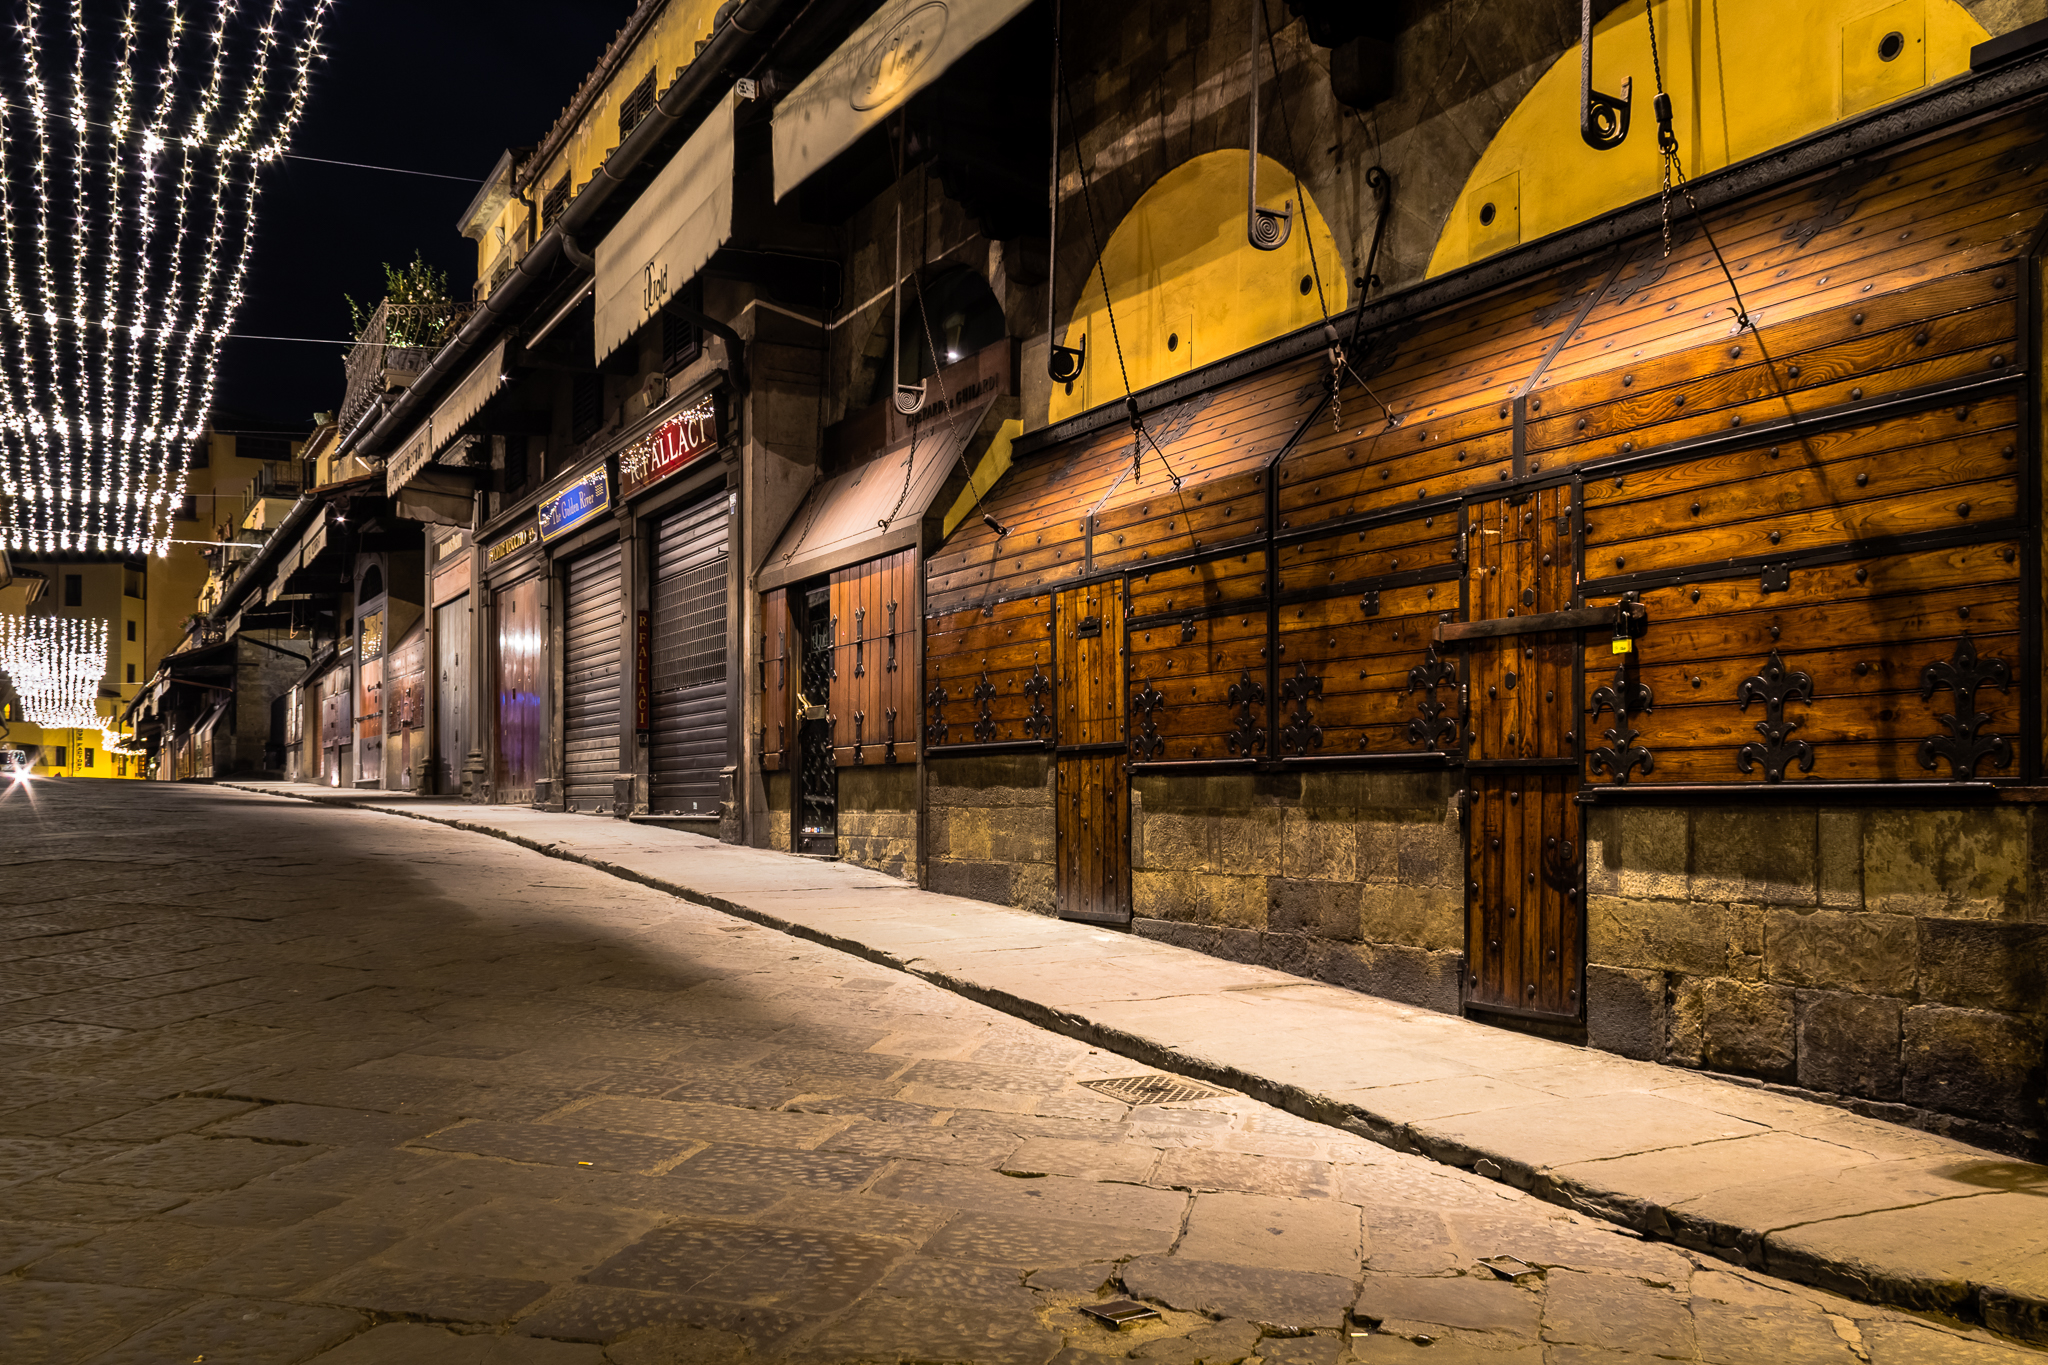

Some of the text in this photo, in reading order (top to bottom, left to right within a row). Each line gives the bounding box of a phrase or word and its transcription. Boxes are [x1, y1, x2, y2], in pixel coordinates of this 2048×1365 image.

[561, 497, 580, 519] Golden
[579, 490, 595, 510] River
[638, 632, 647, 724] FALLACI
